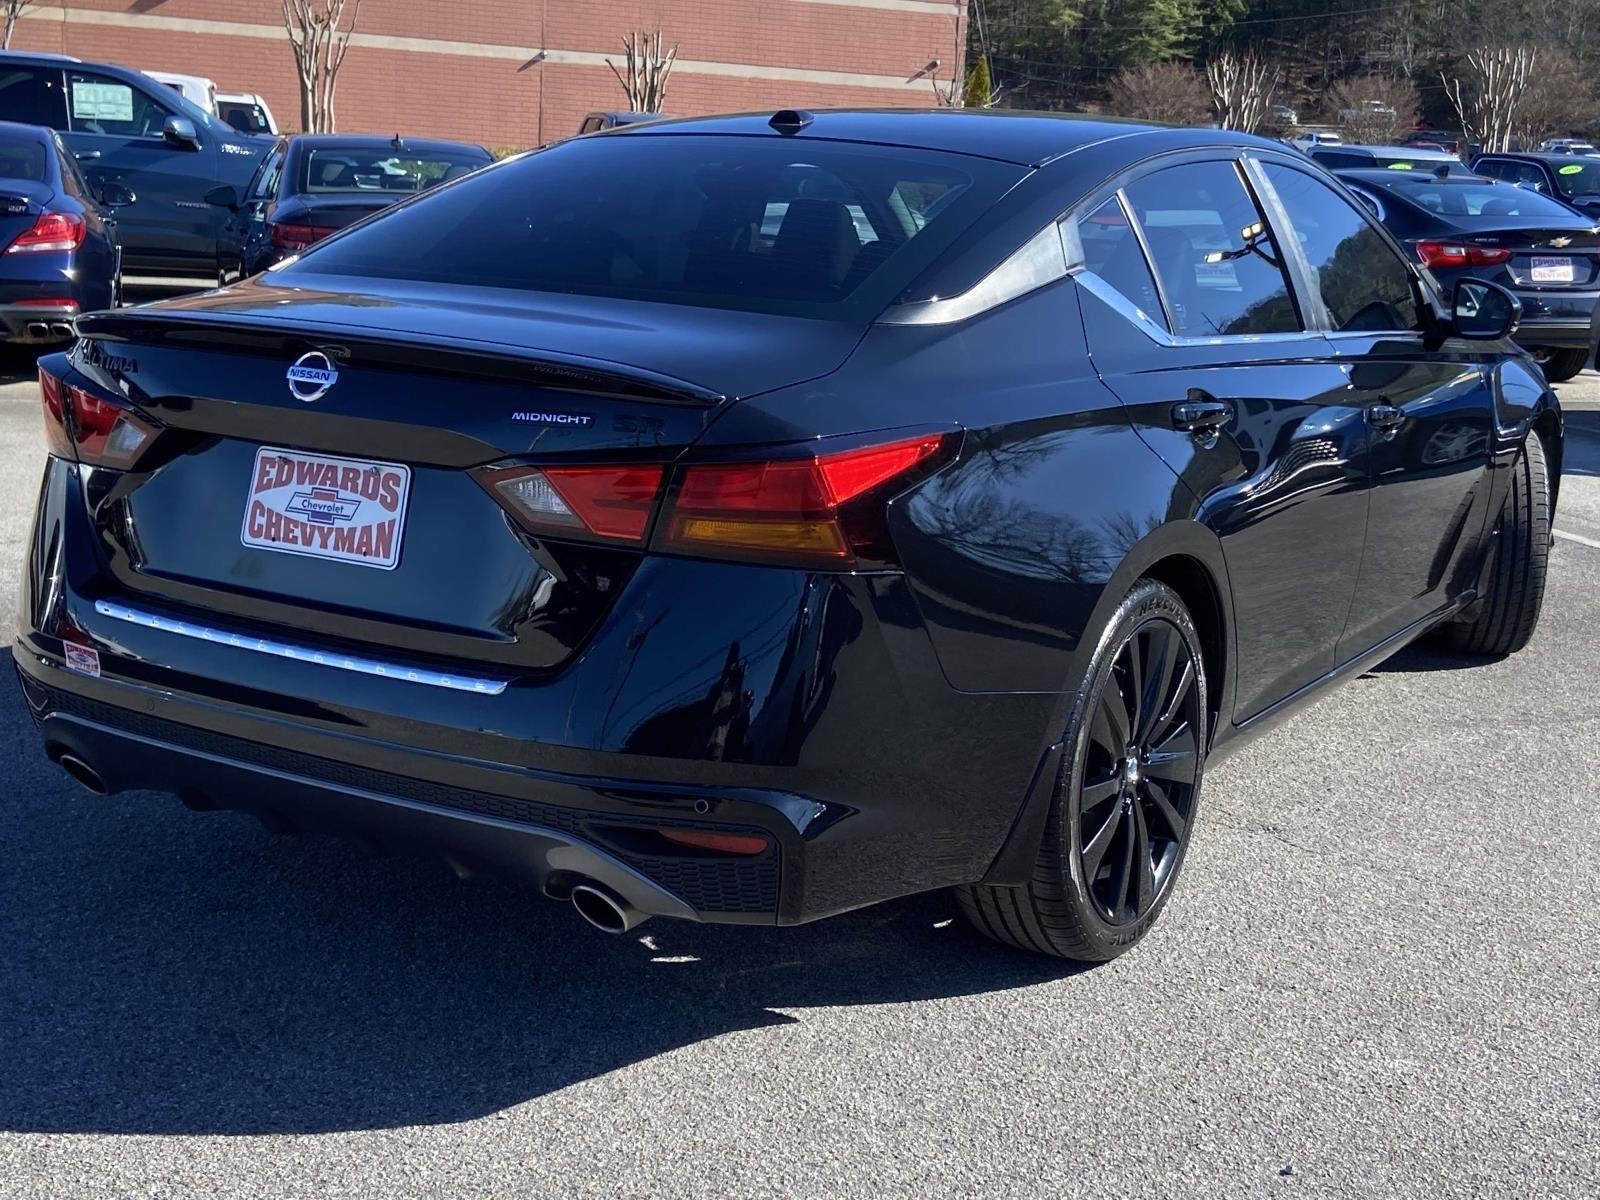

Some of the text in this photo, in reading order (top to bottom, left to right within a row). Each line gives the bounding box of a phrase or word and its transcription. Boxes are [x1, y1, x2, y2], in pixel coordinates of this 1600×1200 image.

[290, 368, 330, 381] NISSAN
[511, 412, 591, 424] MIDNIGHT
[255, 455, 402, 513] EDWARDS
[301, 499, 344, 514] Chevrolet
[248, 499, 396, 560] CHEVYMAN
